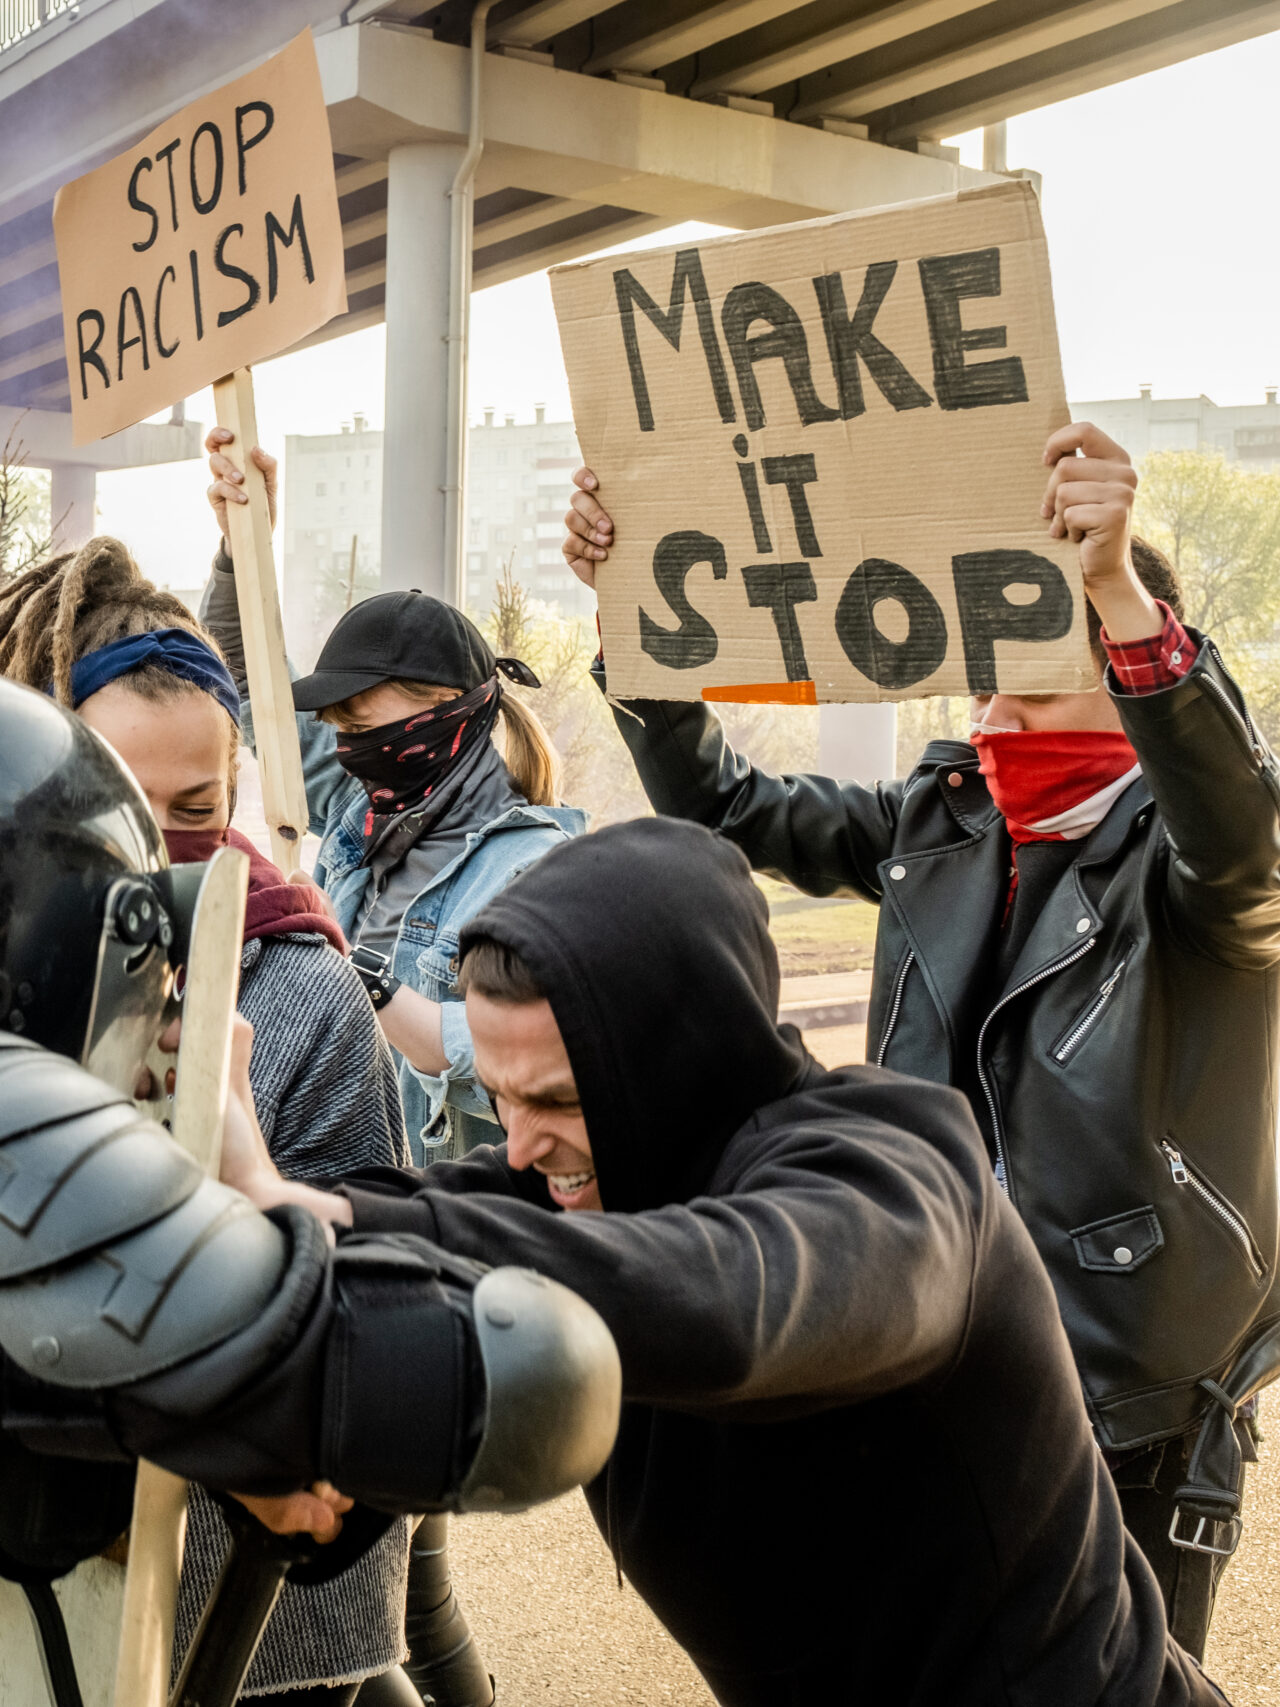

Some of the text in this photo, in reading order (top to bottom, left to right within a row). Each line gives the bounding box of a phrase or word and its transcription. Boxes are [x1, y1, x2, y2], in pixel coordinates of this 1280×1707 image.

[128, 101, 274, 252] STOP
[77, 194, 315, 399] RACISM
[613, 248, 1029, 432] MAKE
[638, 530, 1074, 695] STOP
